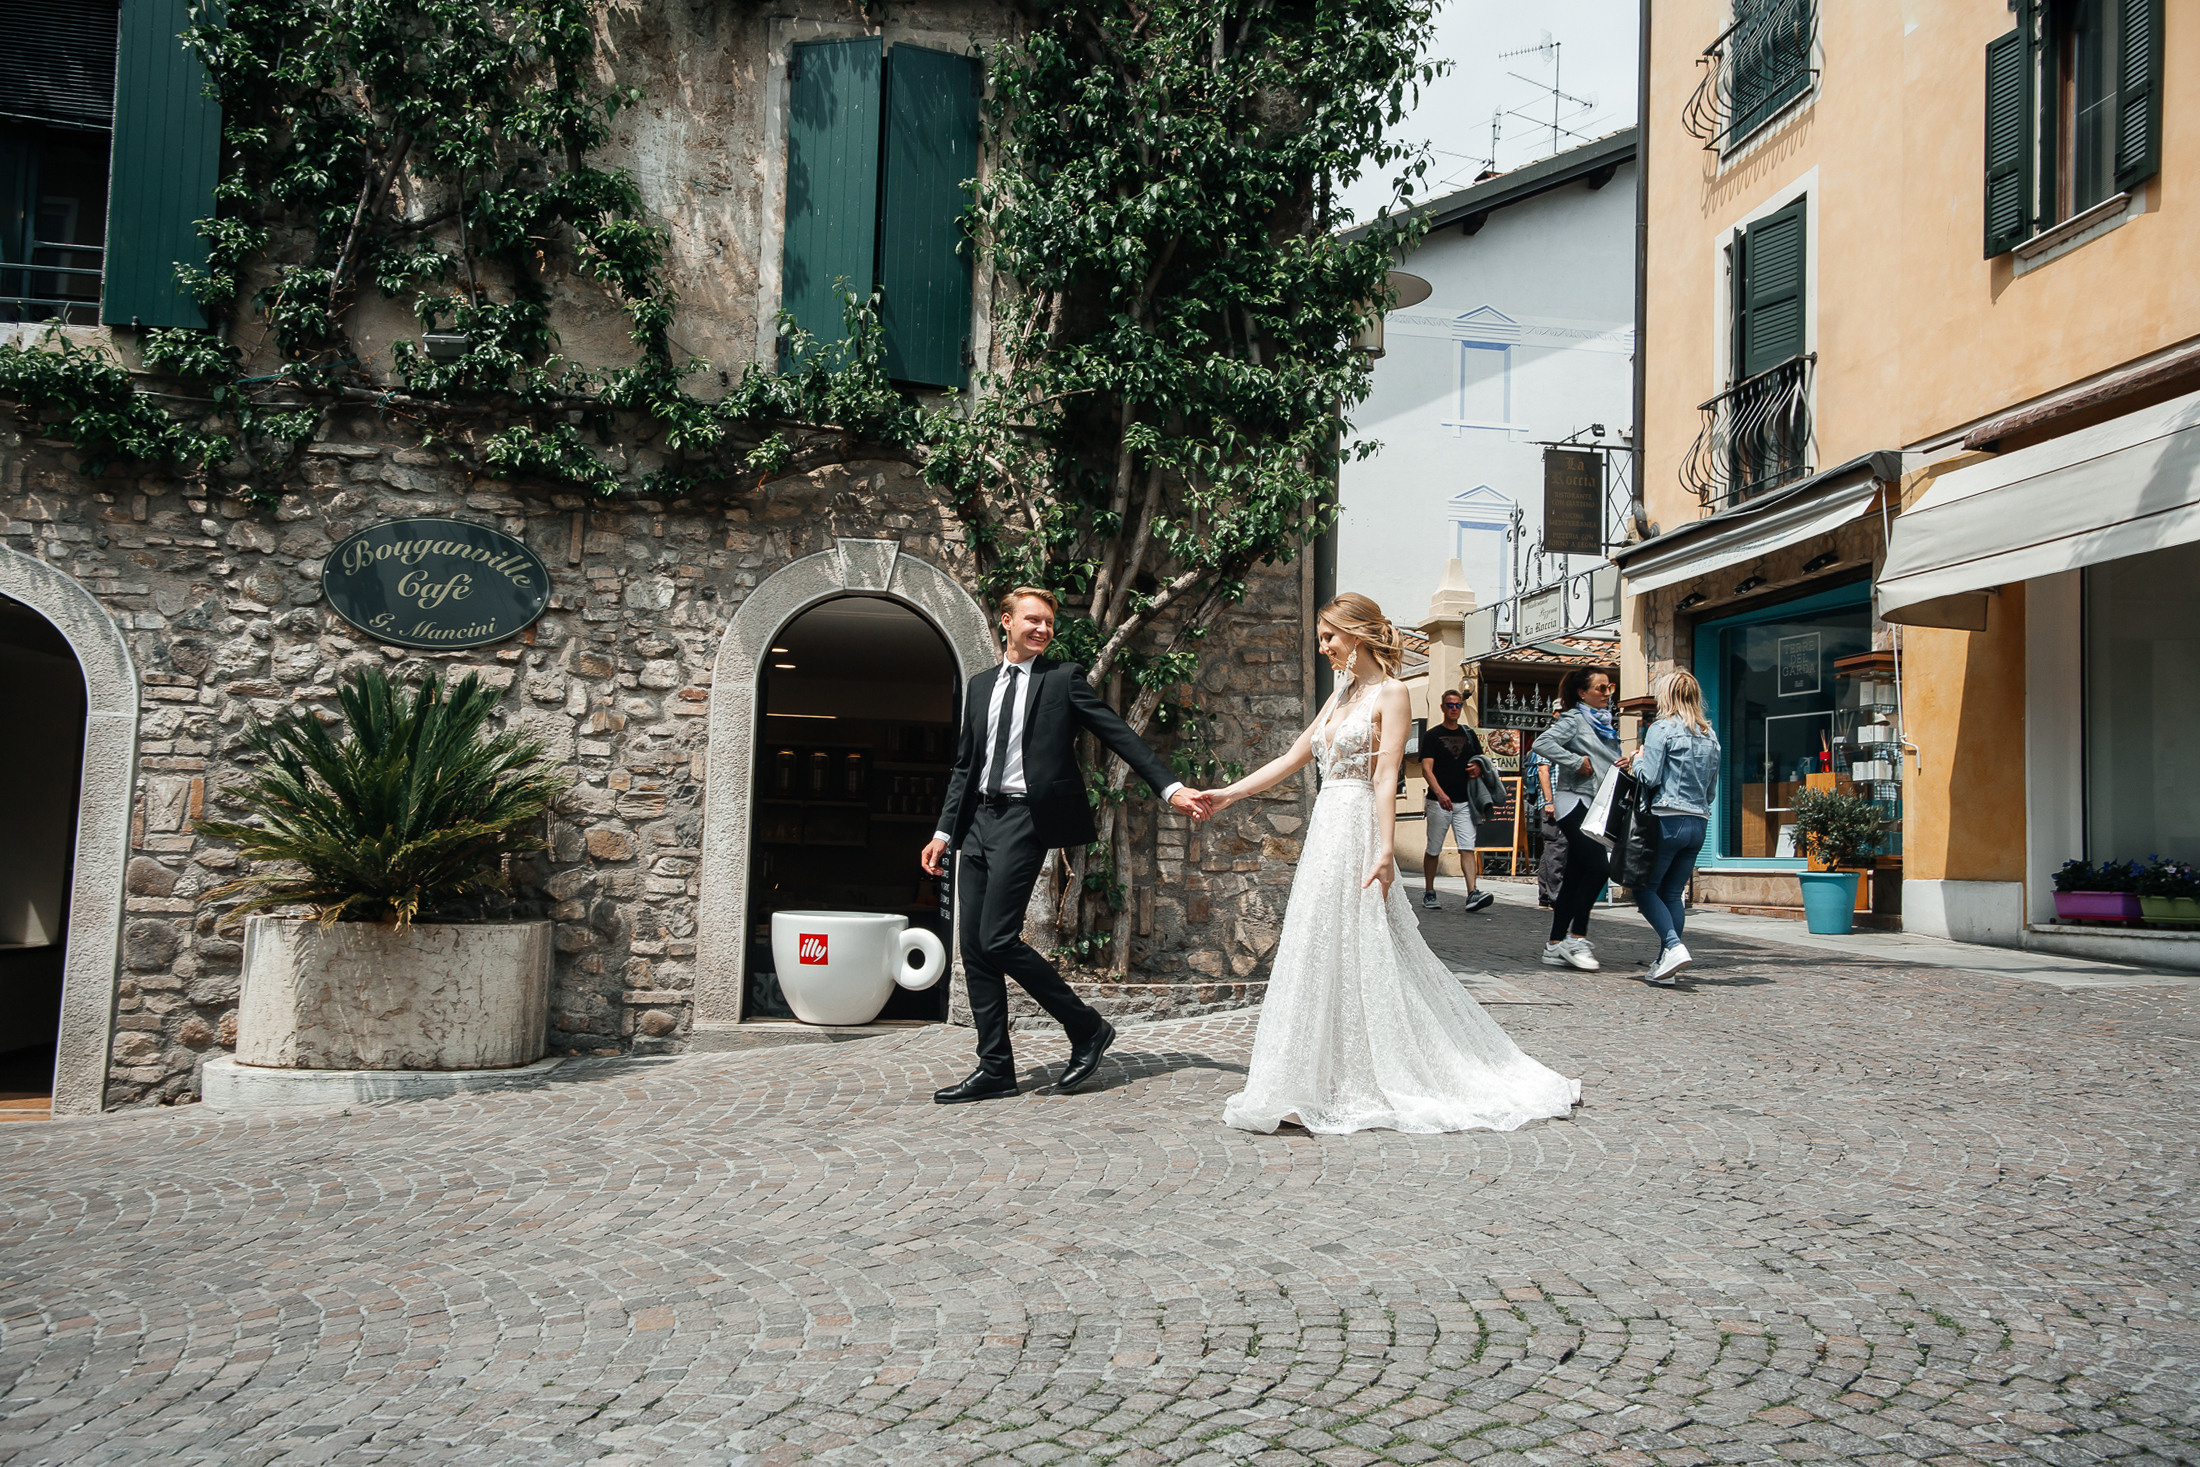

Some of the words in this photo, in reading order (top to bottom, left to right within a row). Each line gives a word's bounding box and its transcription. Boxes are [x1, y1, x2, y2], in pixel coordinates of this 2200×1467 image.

[1564, 456, 1585, 472] La
[1551, 470, 1596, 488] Roccia
[1554, 491, 1592, 500] RISTORANTE
[342, 539, 532, 588] Bouganville
[398, 569, 474, 610] Café
[369, 612, 396, 632] G.
[398, 618, 497, 640] Mancini
[1783, 640, 1816, 655] TERRE
[1790, 654, 1808, 665] DEL
[1782, 664, 1816, 677] GARDA
[1492, 757, 1518, 768] ETANA
[801, 938, 826, 962] illy
